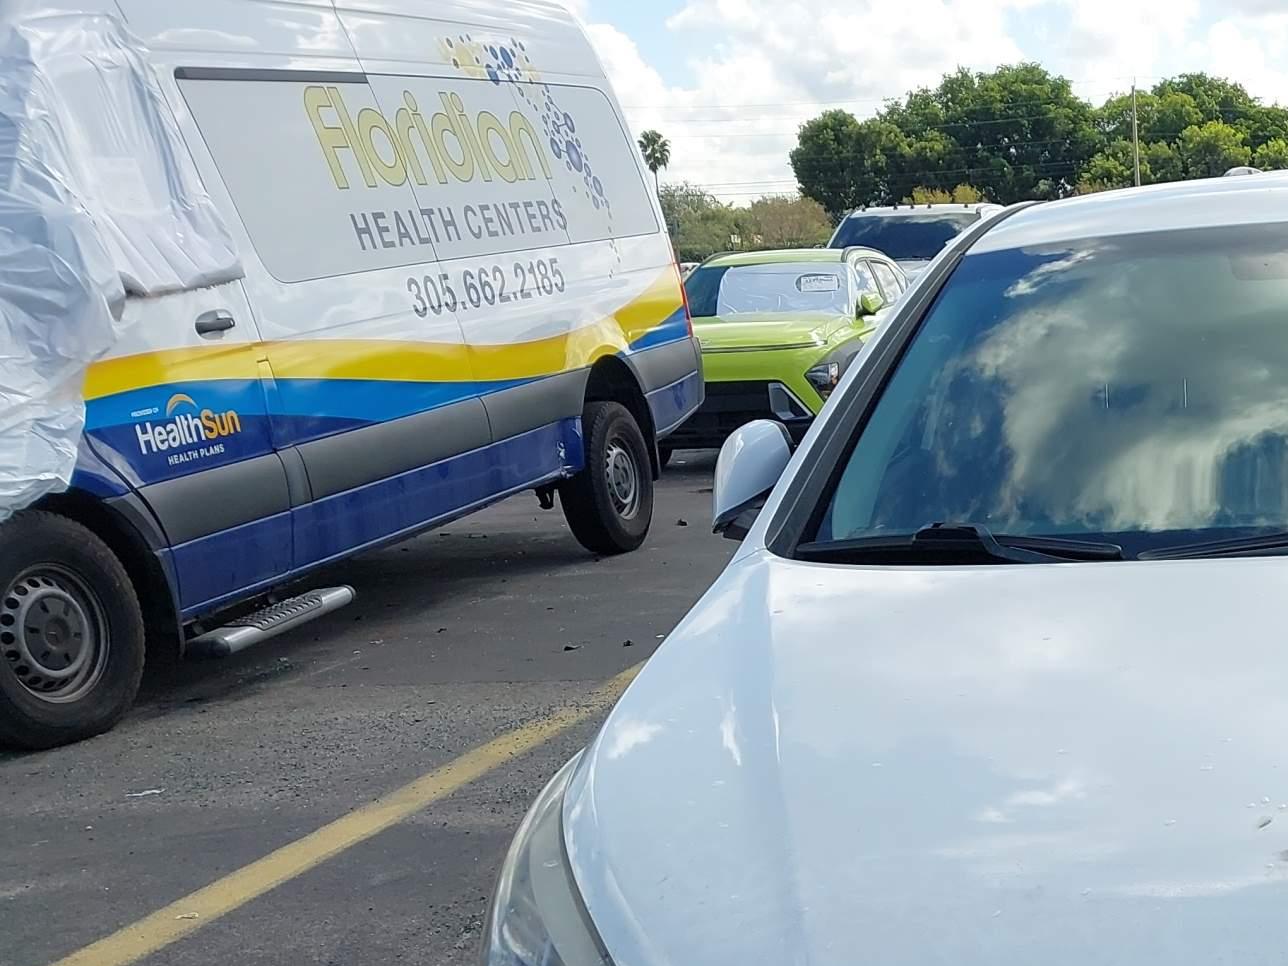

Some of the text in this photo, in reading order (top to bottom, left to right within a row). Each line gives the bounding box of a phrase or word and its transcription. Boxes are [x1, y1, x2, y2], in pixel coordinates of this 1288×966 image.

[303, 85, 553, 190] Floridian
[349, 198, 568, 251] HEALTH CENTERS
[406, 257, 566, 318] 305.662.2185
[134, 408, 242, 455] HealthSun
[167, 443, 225, 466] HEALTH PLANS
